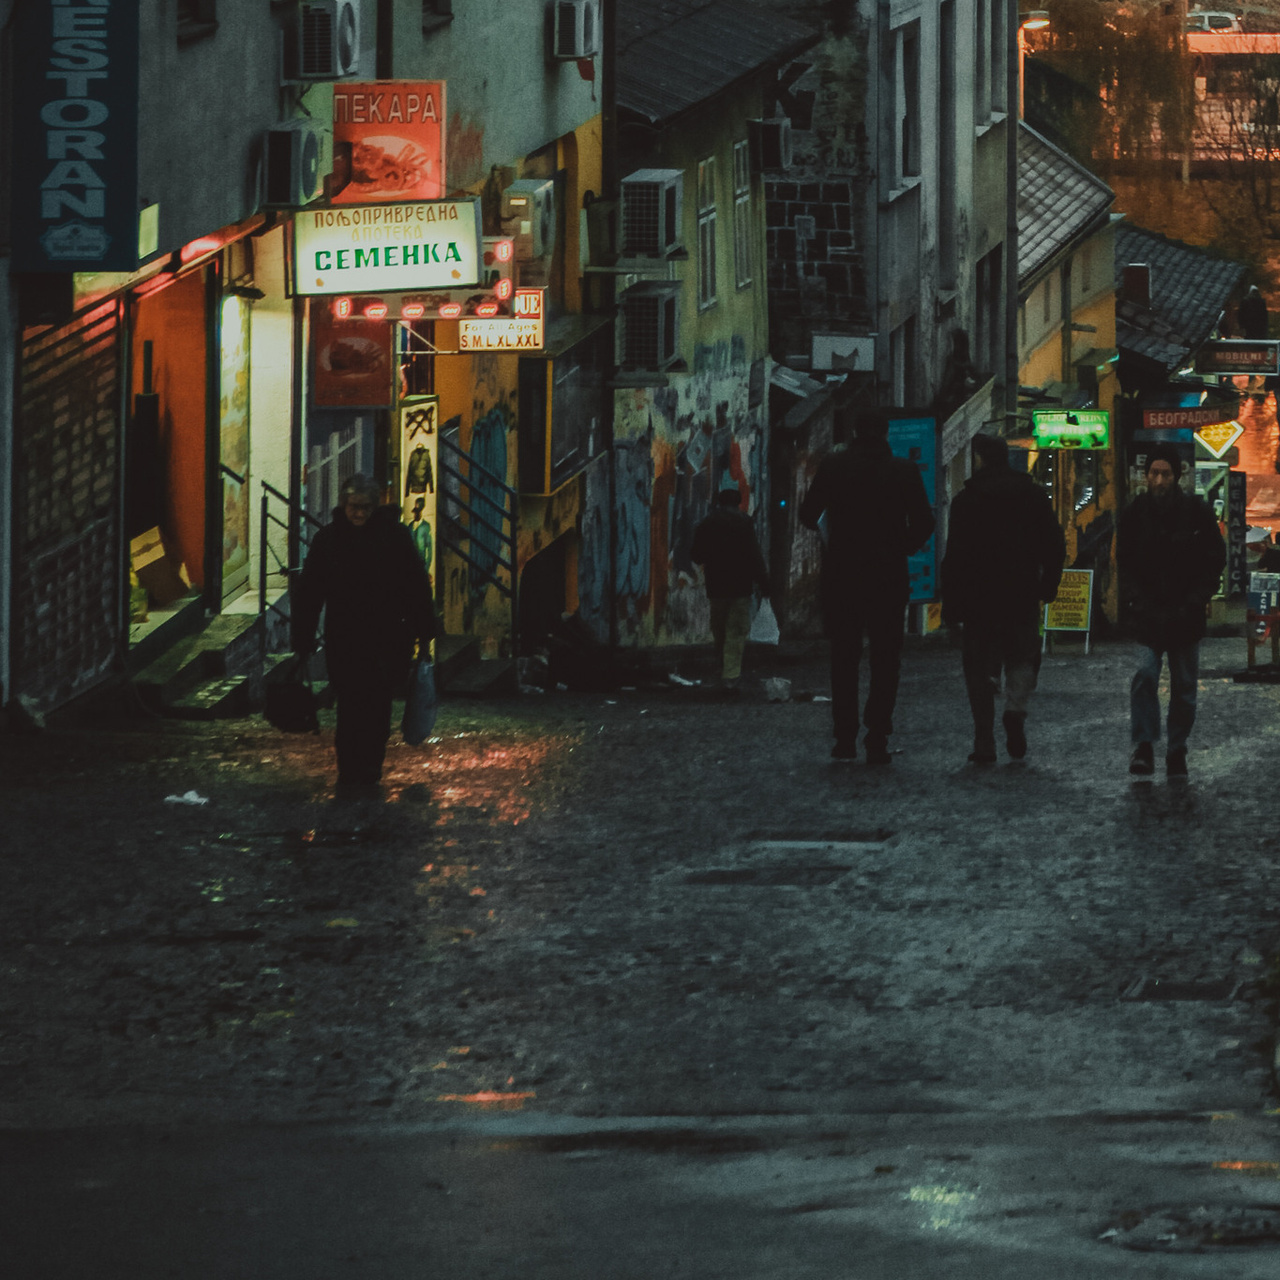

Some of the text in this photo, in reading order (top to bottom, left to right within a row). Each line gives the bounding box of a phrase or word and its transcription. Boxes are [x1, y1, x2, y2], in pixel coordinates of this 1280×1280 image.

[333, 92, 437, 124] ПЕКАРА
[315, 203, 459, 228] ПОЉОПРИВРЕДНА
[315, 241, 462, 271] СЕМЕНКА
